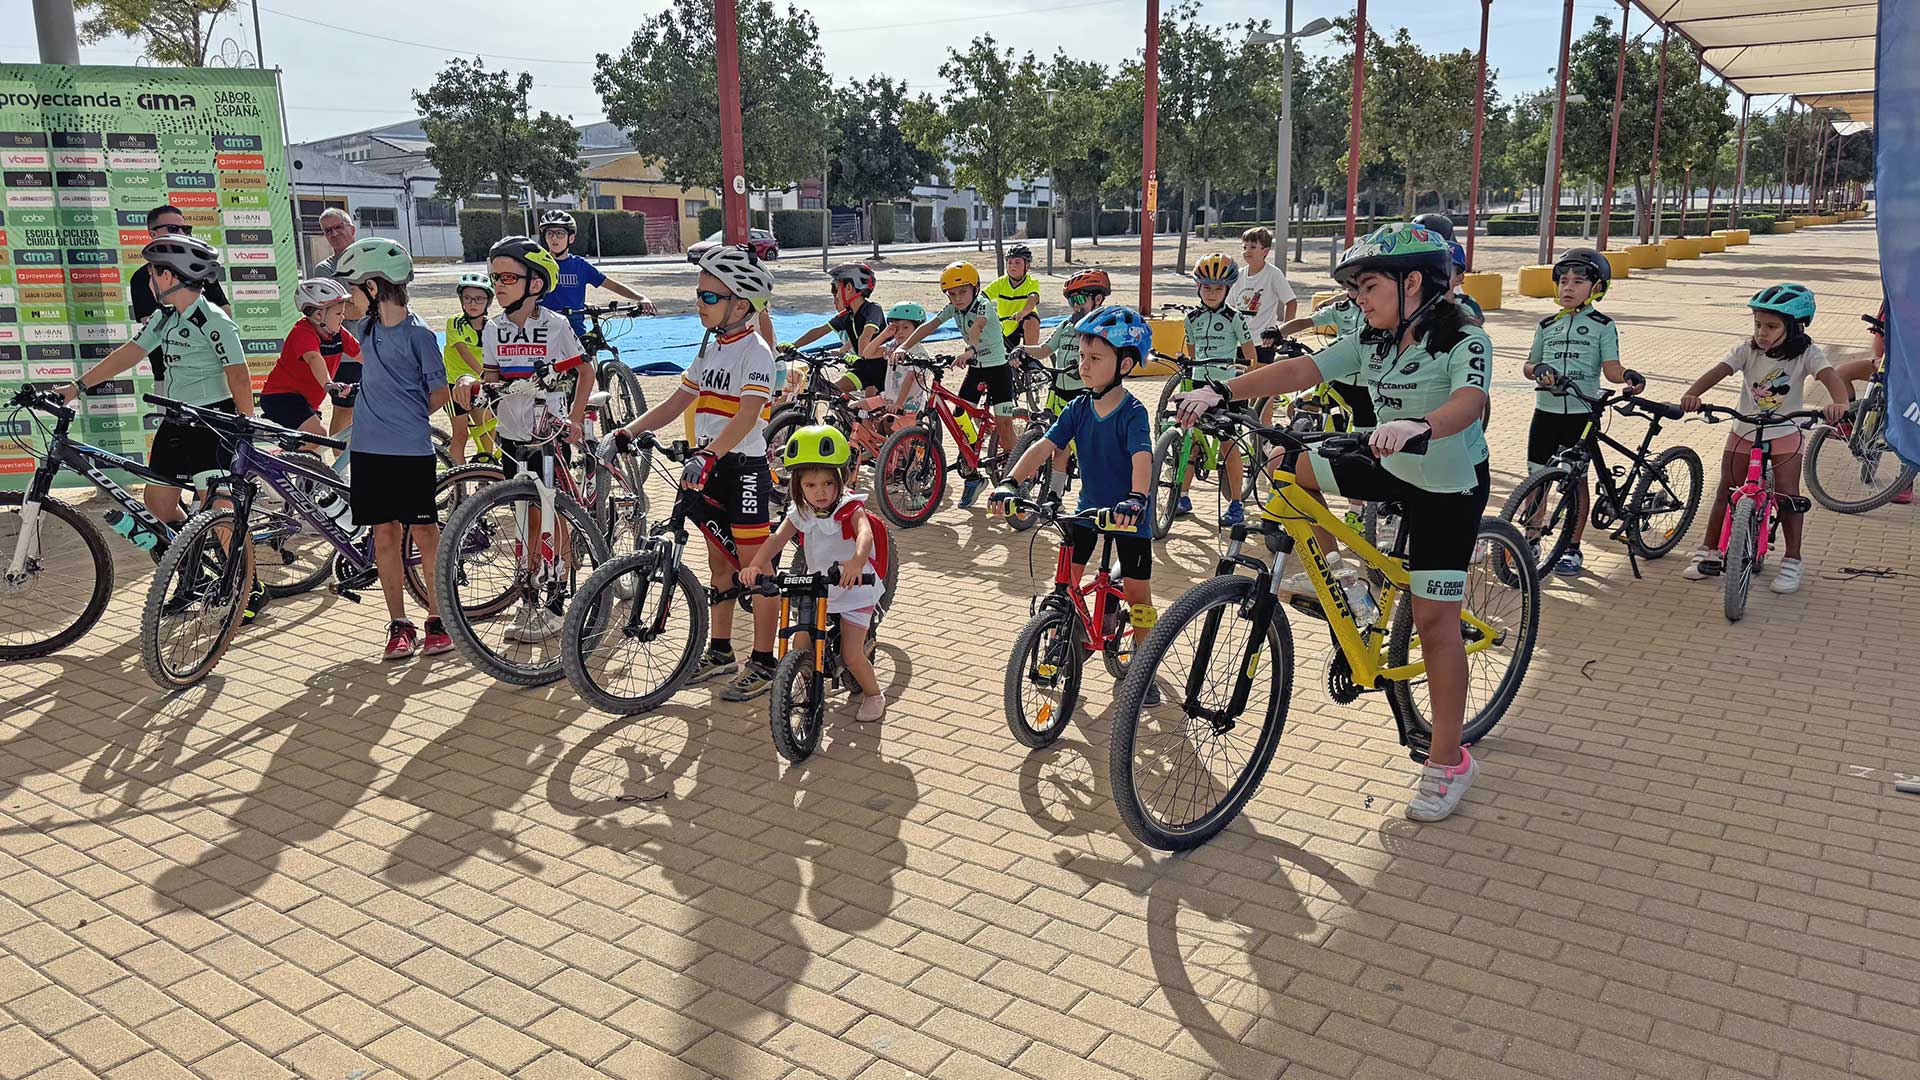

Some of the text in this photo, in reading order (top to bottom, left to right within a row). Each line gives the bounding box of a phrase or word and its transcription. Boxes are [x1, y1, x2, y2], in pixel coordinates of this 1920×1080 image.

[0, 92, 121, 110] proyectanda
[214, 91, 252, 104] SABOR
[216, 104, 260, 118] ESPAÑA
[226, 157, 262, 166] proyectanda
[126, 214, 147, 223] cim
[25, 229, 99, 238] ESCUELA CICLISTA
[26, 237, 100, 247] CIUDAD DE LUCENA
[25, 272, 63, 281] proyectanda
[79, 272, 118, 281] proyectanda
[497, 327, 549, 344] UAE
[499, 346, 545, 355] Emirates
[0, 461, 33, 470] oyectanda
[740, 472, 758, 514] ESPAÑ
[783, 576, 814, 584] BERG
